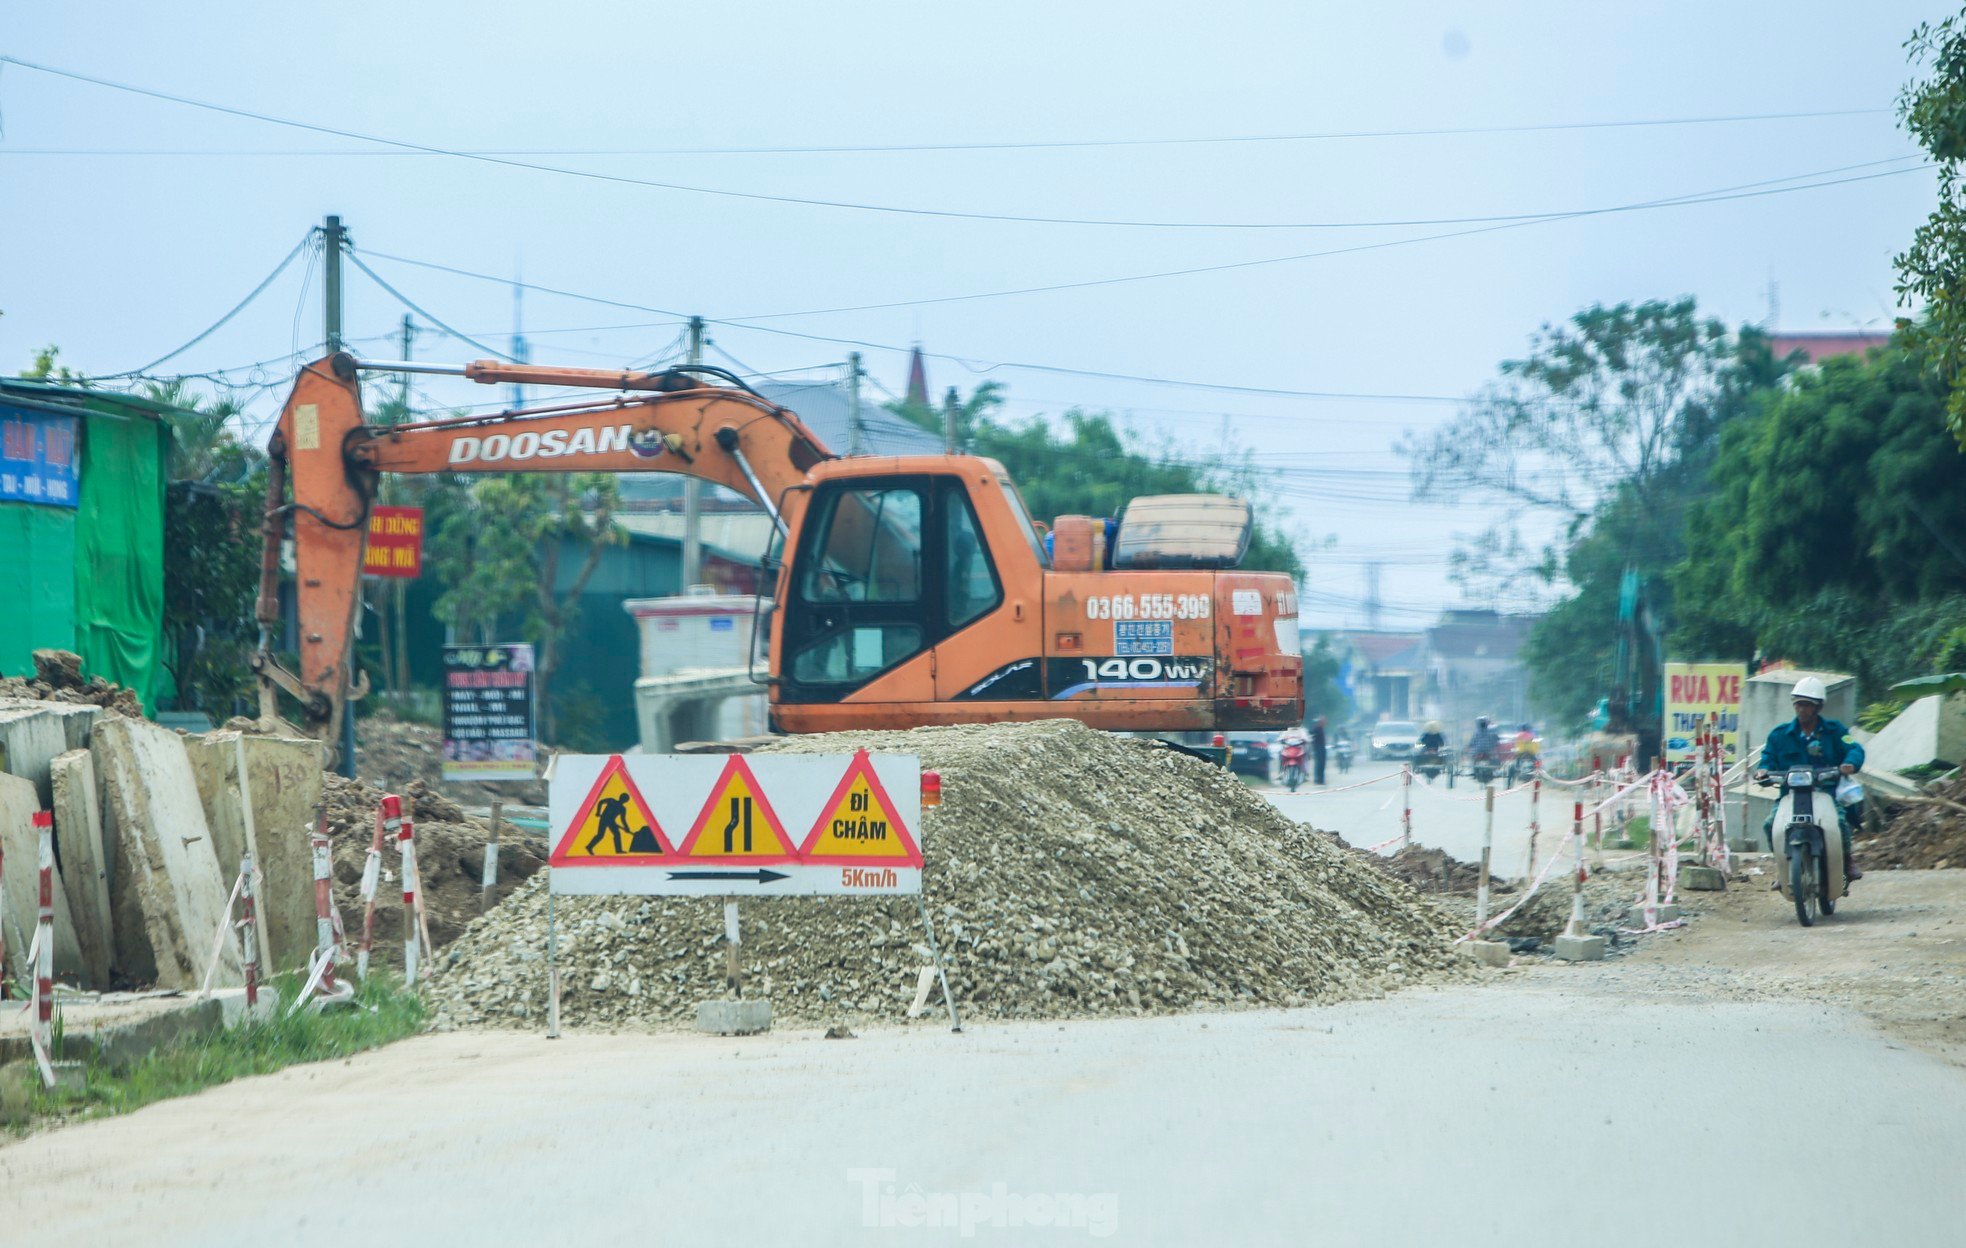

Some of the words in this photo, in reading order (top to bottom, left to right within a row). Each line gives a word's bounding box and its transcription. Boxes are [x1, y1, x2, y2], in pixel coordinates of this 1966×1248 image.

[447, 424, 633, 464] DOOSAN
[1715, 675, 1741, 704] XE
[832, 815, 887, 844] CHẬM
[841, 867, 898, 889] 5Km/h
